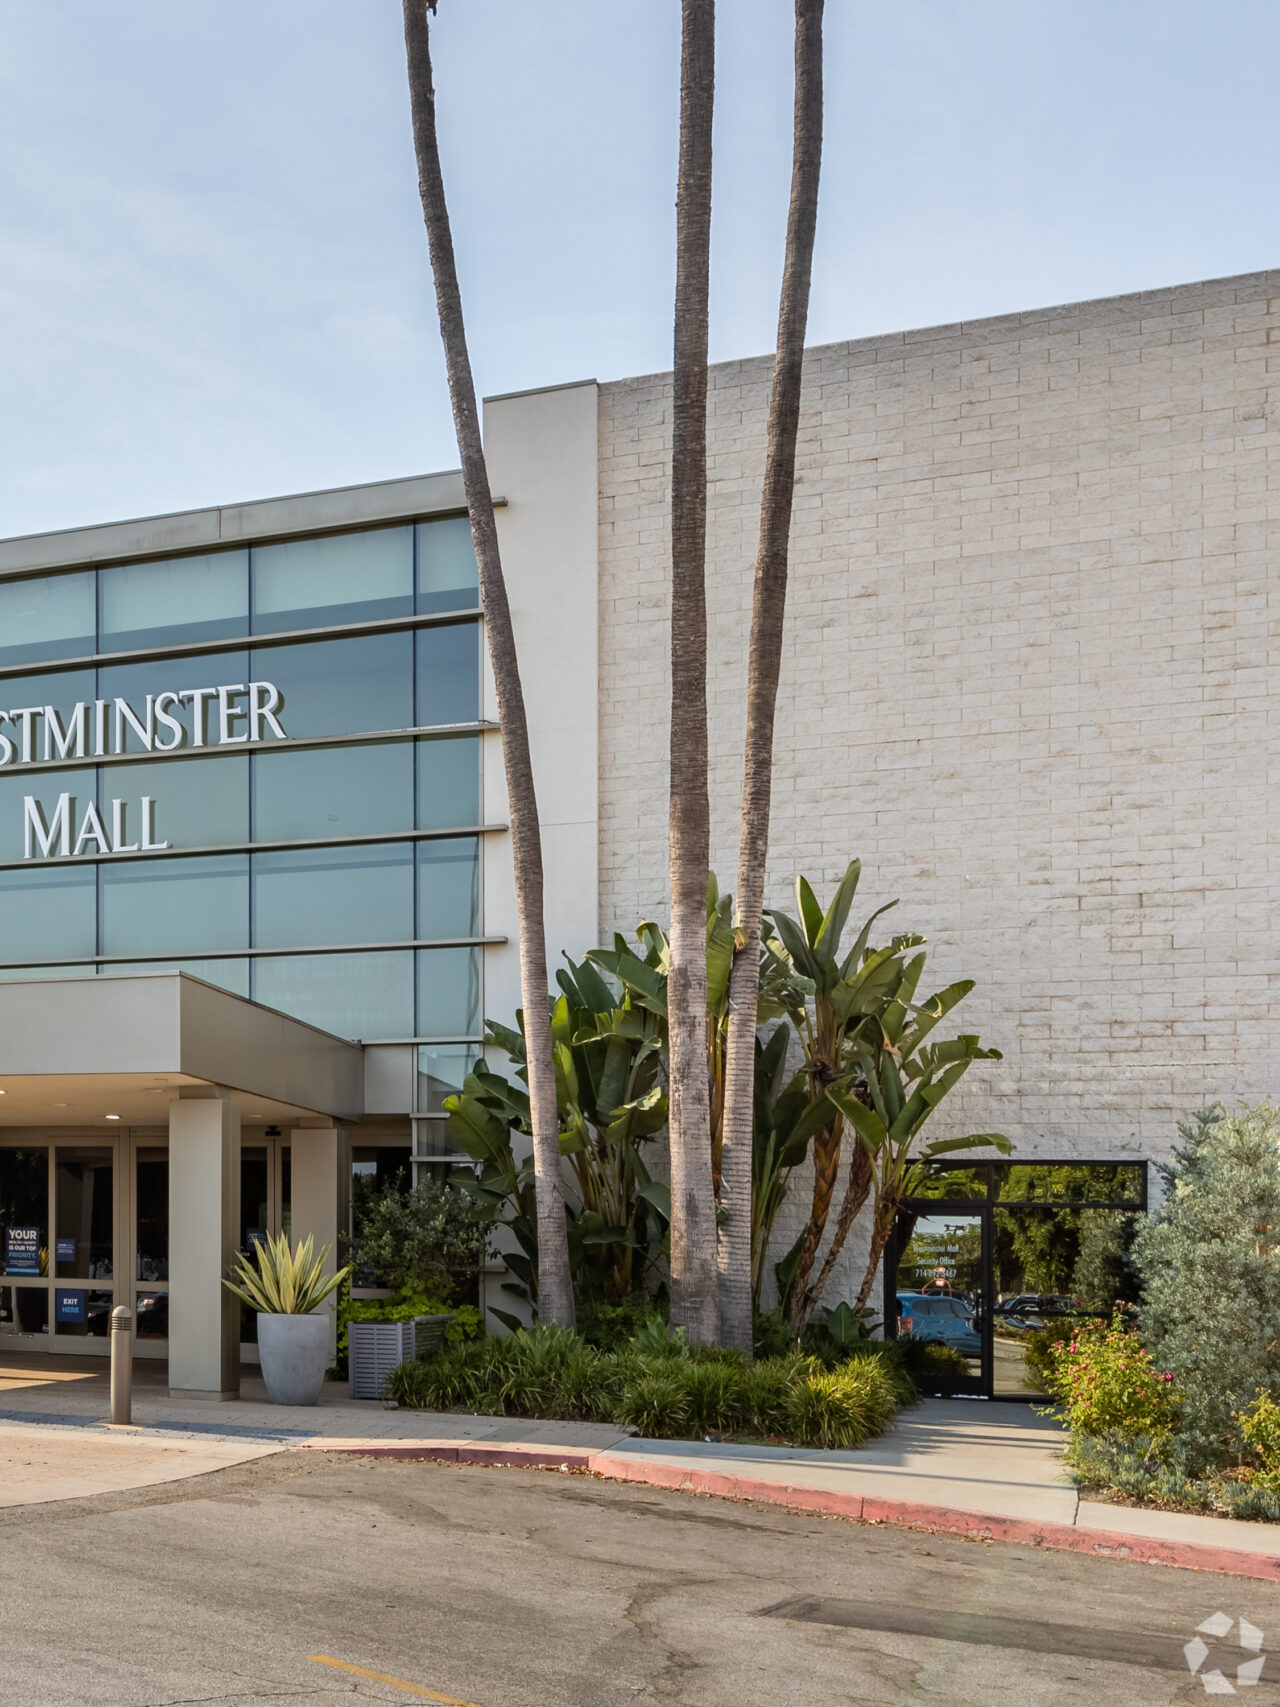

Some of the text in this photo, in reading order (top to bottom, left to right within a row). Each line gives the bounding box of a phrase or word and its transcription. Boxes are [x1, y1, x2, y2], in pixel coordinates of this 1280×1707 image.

[23, 792, 168, 859] MALL
[9, 1229, 37, 1240] YOUR
[947, 1244, 959, 1252] Mall
[917, 1256, 956, 1266] Security Office
